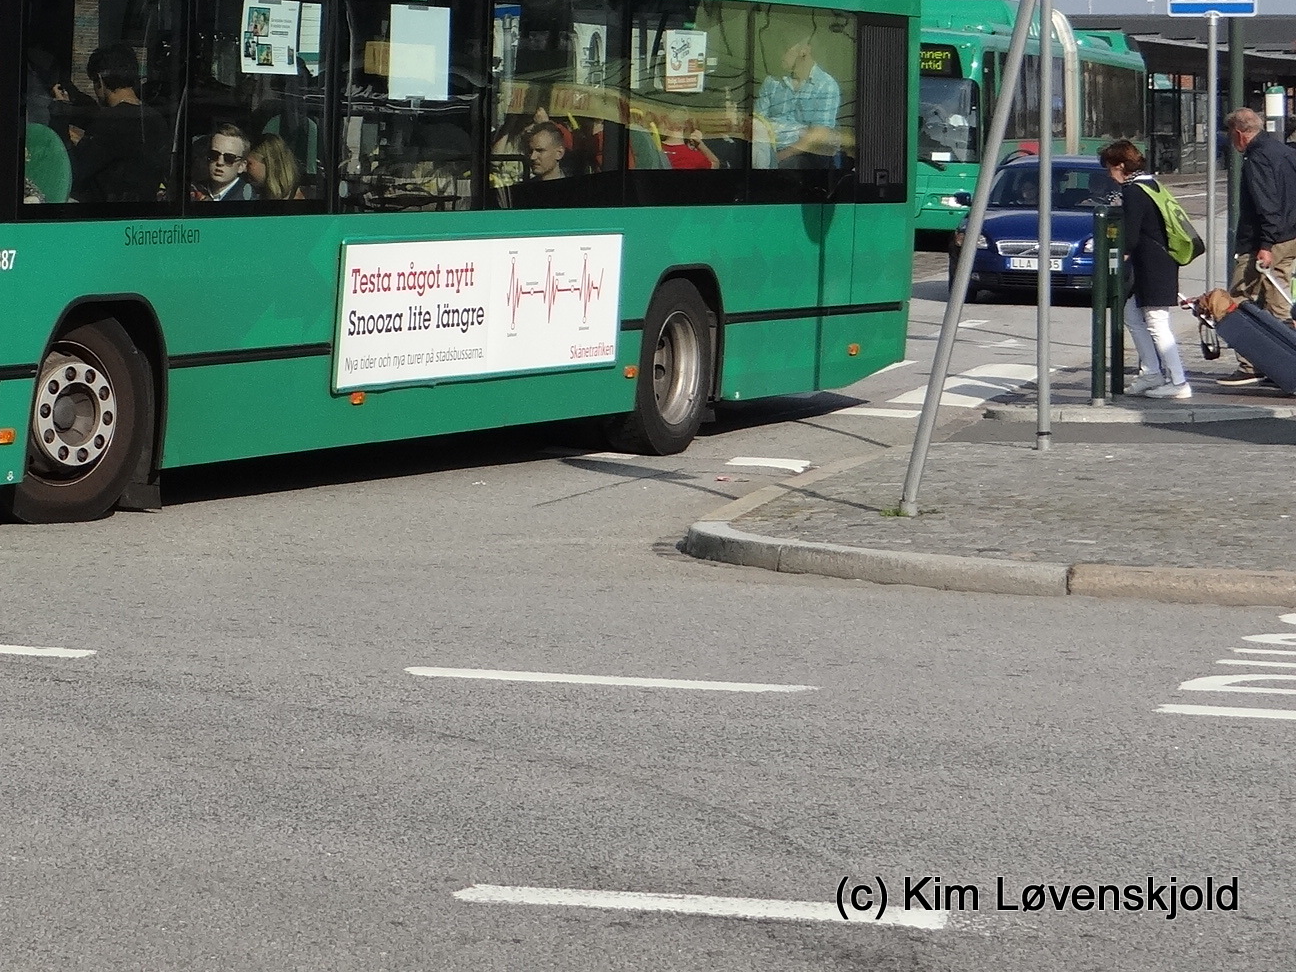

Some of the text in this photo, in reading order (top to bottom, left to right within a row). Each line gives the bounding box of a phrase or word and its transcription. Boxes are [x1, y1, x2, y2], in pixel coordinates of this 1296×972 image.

[124, 224, 200, 246] Skånetrafiken
[1012, 259, 1032, 268] LLA
[351, 261, 474, 297] Testa något nytt
[348, 303, 484, 336] Snooza lite längre
[345, 357, 358, 374] Nya
[360, 354, 377, 370] tider
[378, 353, 391, 367] och
[392, 354, 405, 369] nya
[407, 352, 425, 365] turer
[425, 348, 435, 366] på
[570, 342, 614, 359] Skånetrafiken
